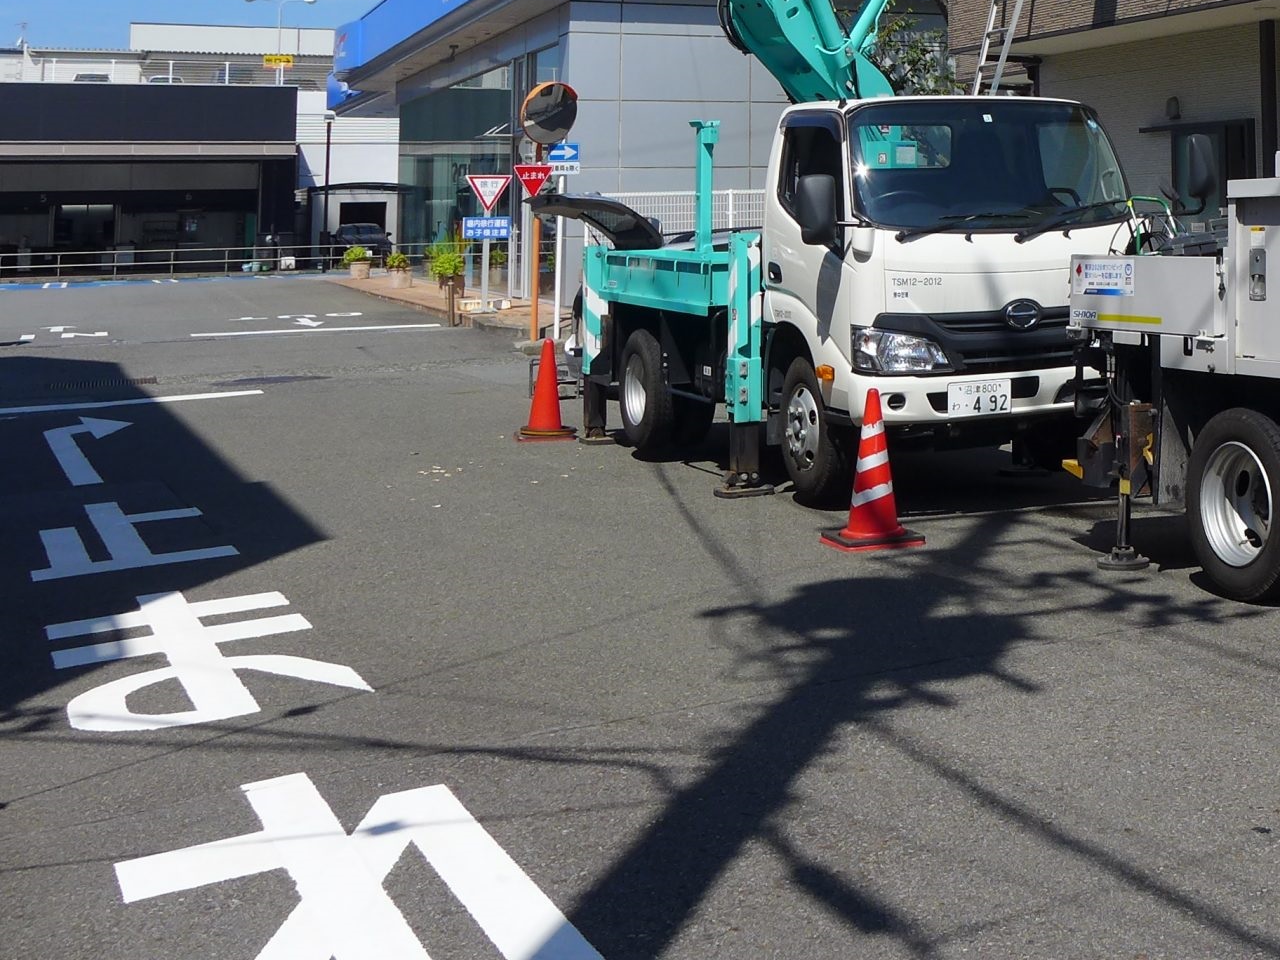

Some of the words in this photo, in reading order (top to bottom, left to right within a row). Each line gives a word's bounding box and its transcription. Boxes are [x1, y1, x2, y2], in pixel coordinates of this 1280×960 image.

[521, 171, 545, 180] 止まれ
[891, 278, 943, 287] TSM12-2012
[1073, 310, 1097, 319] SH10A
